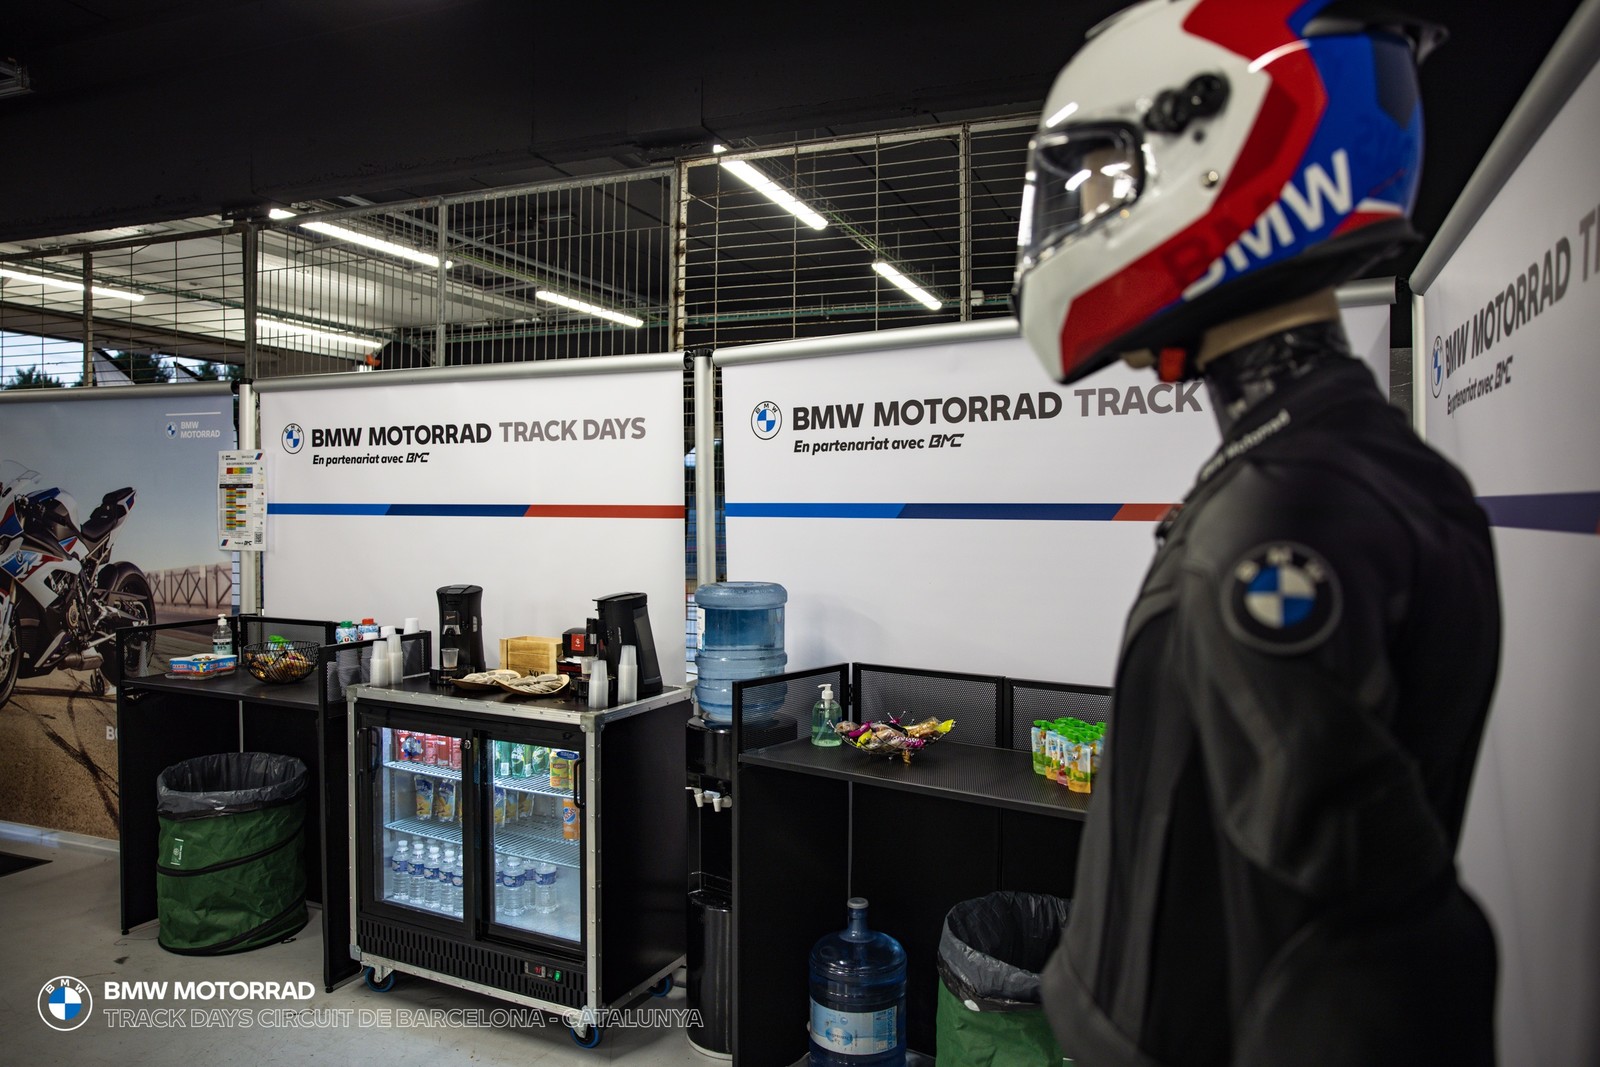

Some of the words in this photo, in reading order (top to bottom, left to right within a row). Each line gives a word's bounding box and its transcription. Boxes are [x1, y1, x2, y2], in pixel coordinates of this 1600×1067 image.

[1164, 148, 1353, 301] BMW
[1446, 321, 1469, 379] BMW
[1471, 237, 1571, 360] MOTORRAD
[1579, 203, 1600, 281] T
[1477, 374, 1493, 397] avec
[793, 403, 864, 430] BMW
[874, 391, 1062, 427] MOTORRAD
[1074, 381, 1204, 417] TRACK
[180, 421, 199, 430] BMW
[180, 430, 221, 438] MOTORRAD
[312, 427, 362, 448] BMW
[369, 423, 492, 447] MOTORRAD
[499, 420, 577, 442] TRACK
[583, 417, 646, 440] DAYS
[794, 440, 810, 453] En
[812, 436, 889, 456] partenariat
[892, 439, 925, 450] avec
[928, 434, 964, 448] BMC
[313, 455, 325, 465] En
[326, 453, 380, 467] partenariat
[381, 456, 404, 464] avec
